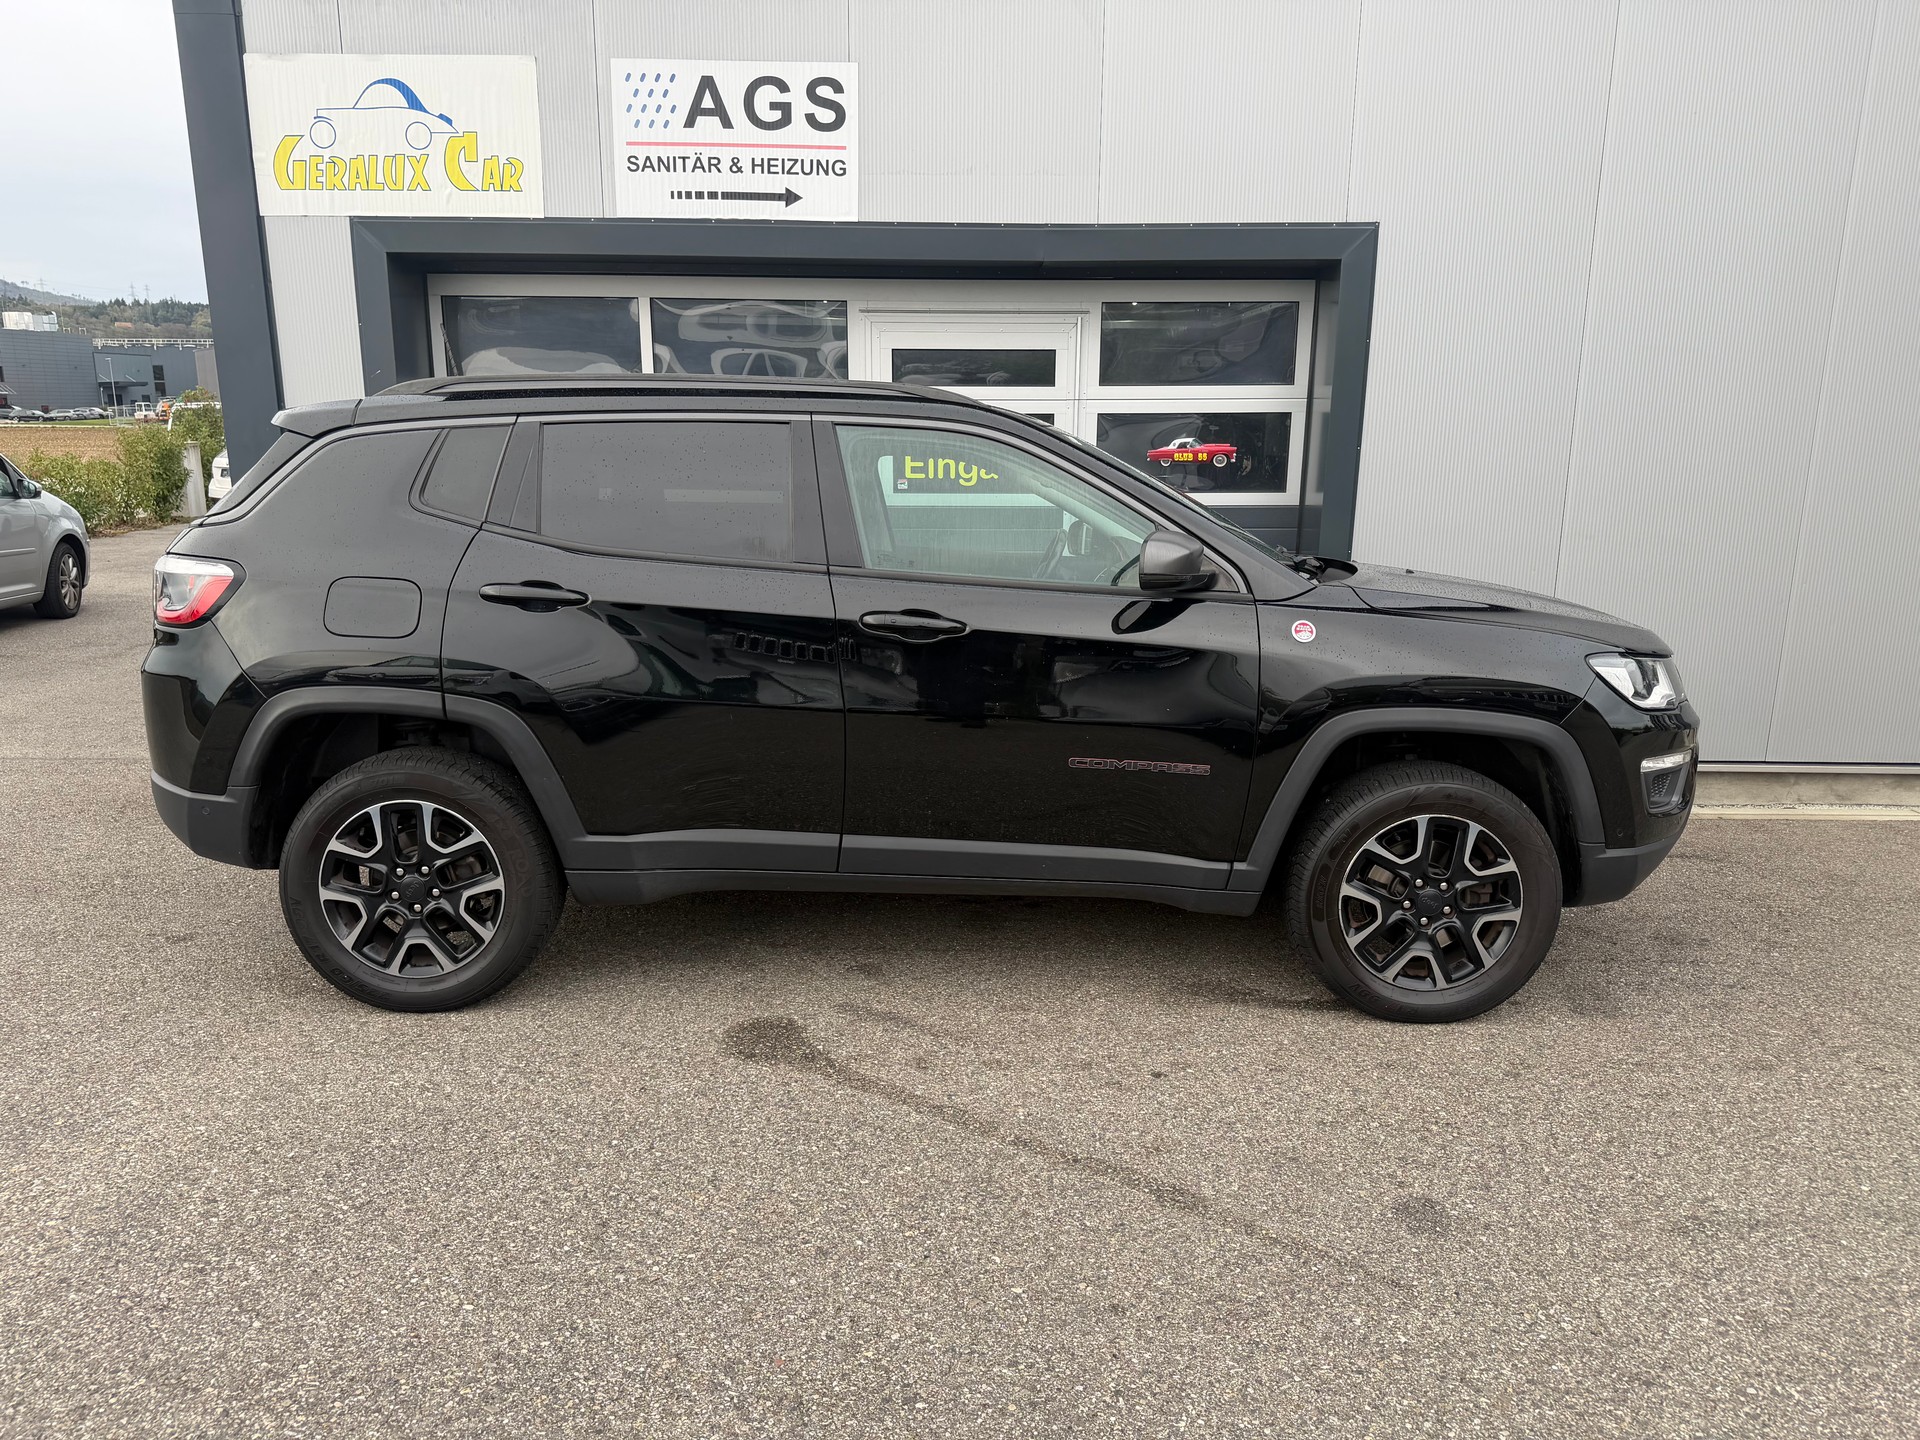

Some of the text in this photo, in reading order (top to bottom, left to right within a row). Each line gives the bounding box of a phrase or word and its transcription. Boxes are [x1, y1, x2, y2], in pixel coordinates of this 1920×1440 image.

[682, 74, 847, 133] AGS
[273, 131, 524, 192] GERALUX CAR
[626, 152, 847, 177] SANITÄR & HEIZUNG
[1068, 757, 1211, 776] COMPASS
